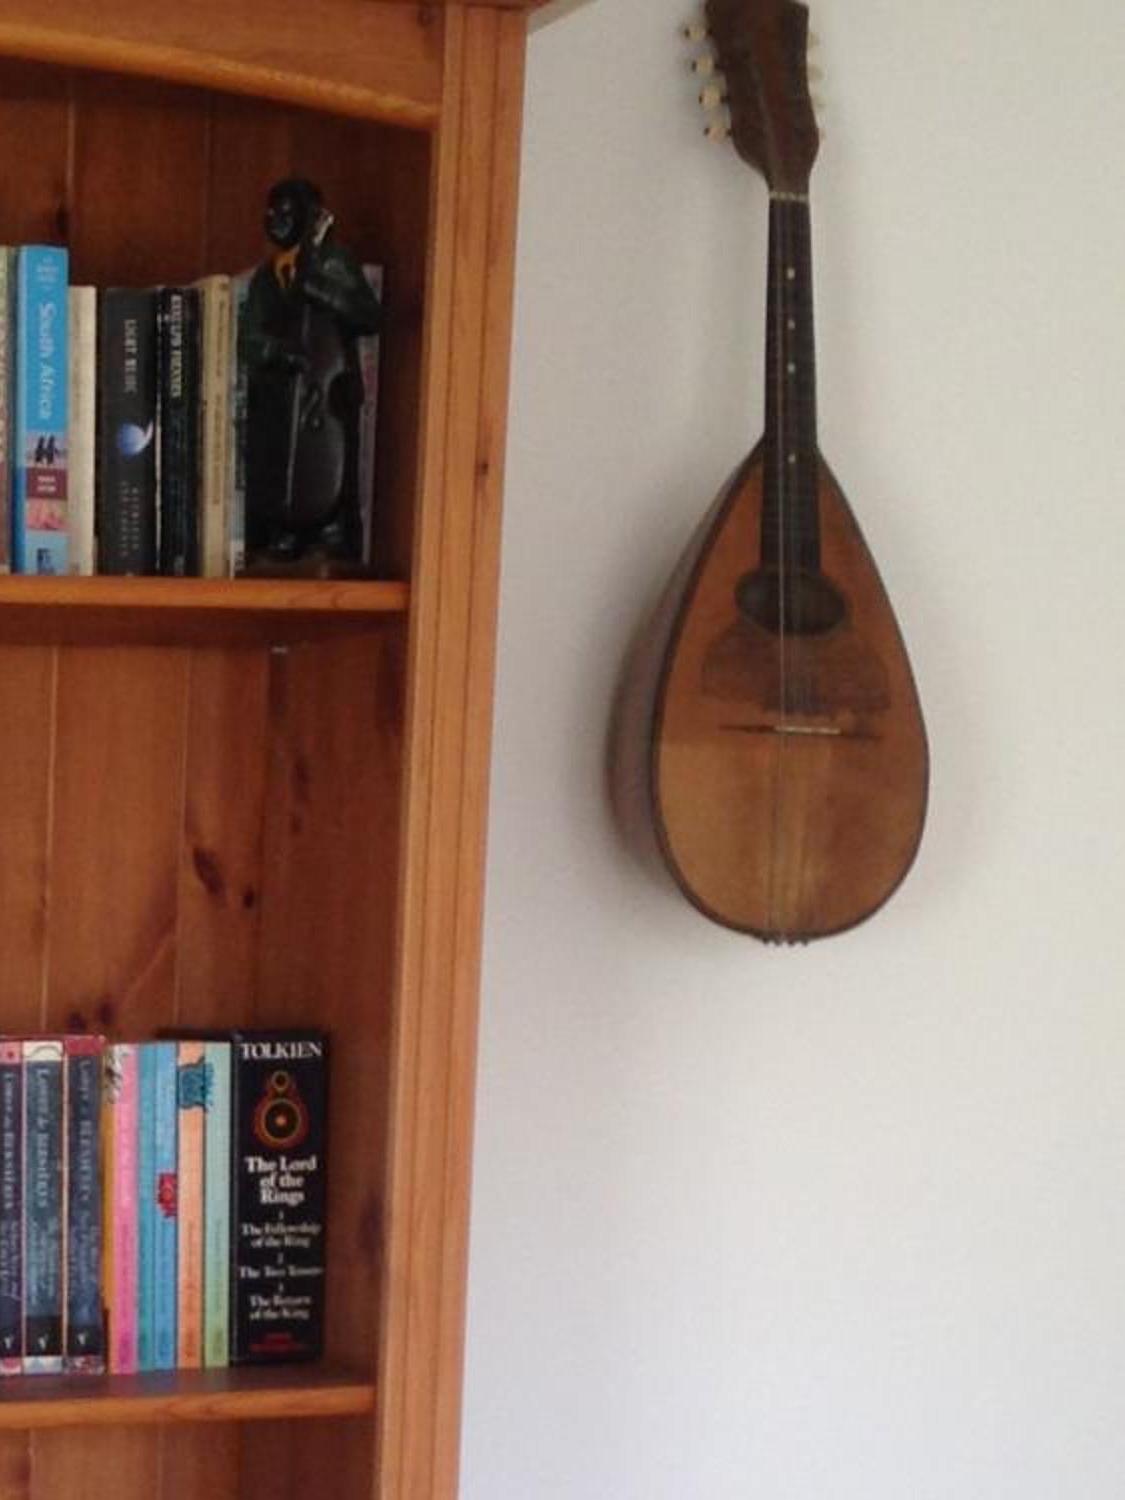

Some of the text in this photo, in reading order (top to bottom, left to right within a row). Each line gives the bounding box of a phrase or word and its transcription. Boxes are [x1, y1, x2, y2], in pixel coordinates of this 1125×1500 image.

[38, 302, 58, 421] South Africa
[240, 1041, 323, 1060] TOLKIEN
[244, 1155, 317, 1174] The Lord
[259, 1172, 305, 1188] of the
[259, 1187, 305, 1206] Rings
[241, 1222, 262, 1236] The
[239, 1265, 261, 1279] The
